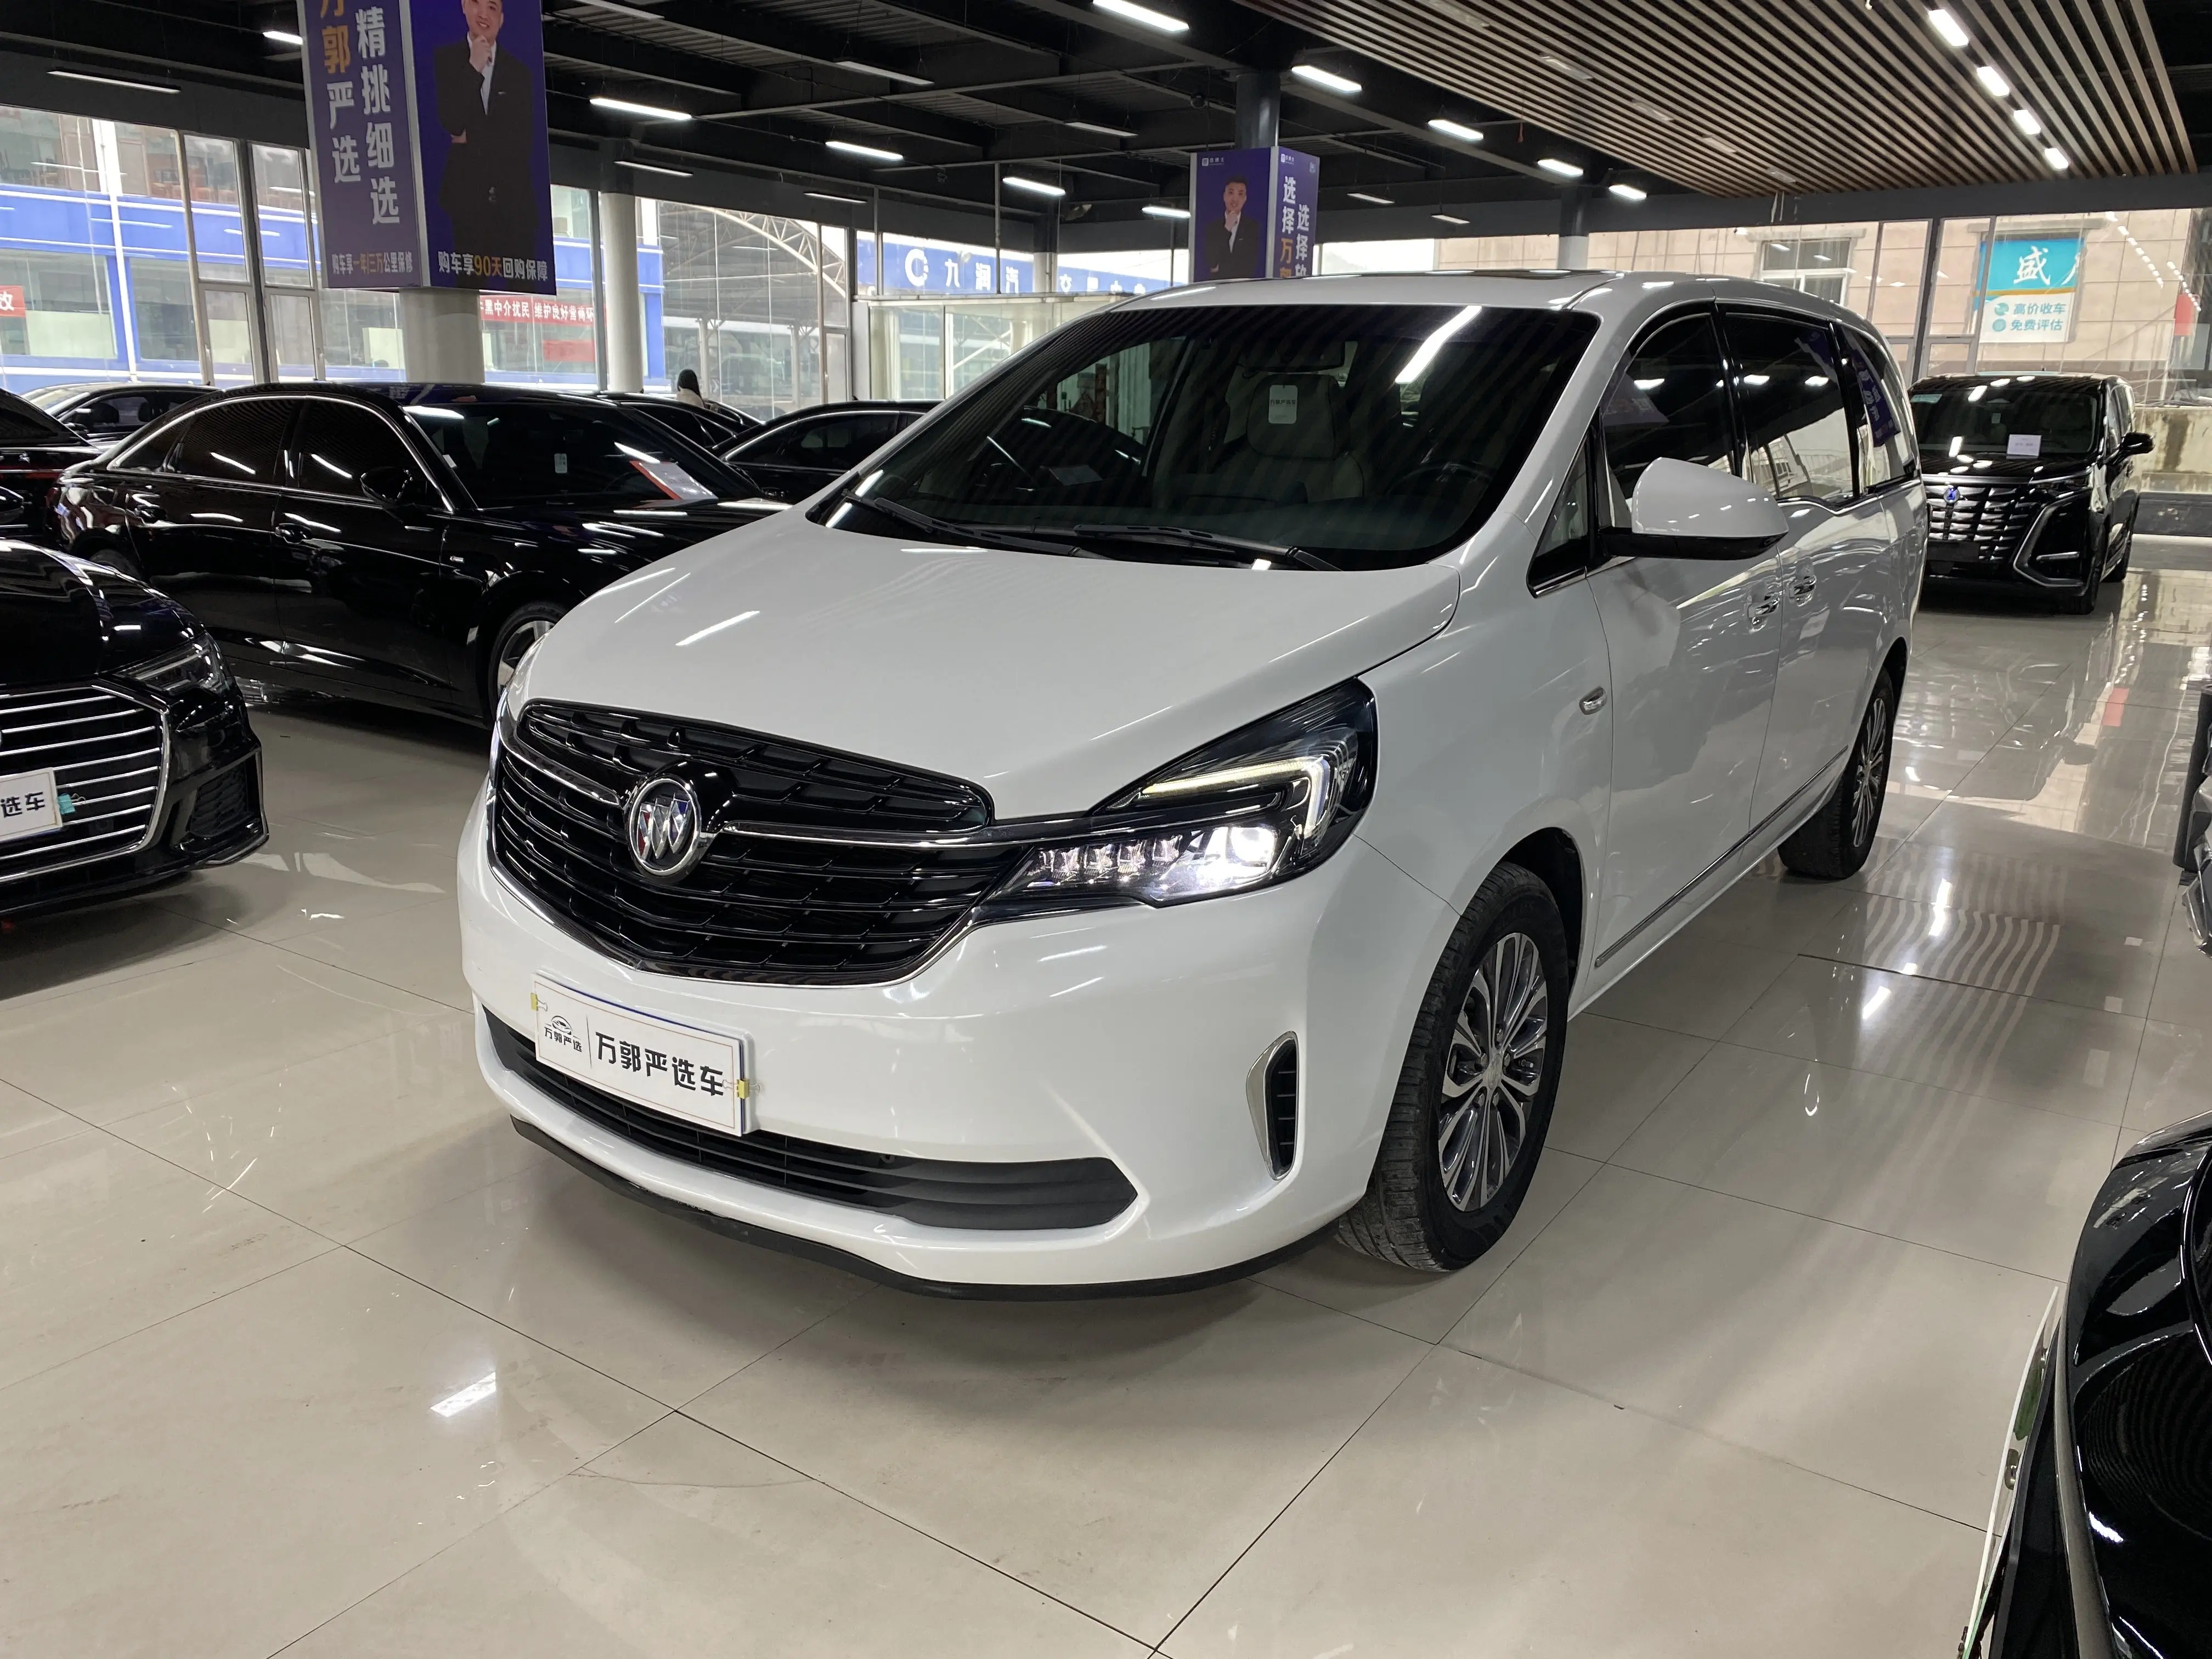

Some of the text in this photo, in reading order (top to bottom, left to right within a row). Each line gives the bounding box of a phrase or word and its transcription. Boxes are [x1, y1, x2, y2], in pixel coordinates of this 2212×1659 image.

[356, 6, 400, 224] 精挑细选
[438, 251, 548, 281] 购车享90天回购保障
[2014, 302, 2066, 314] 高价收车
[2010, 319, 2063, 330] 免费评估
[1, 792, 46, 818] 选车
[544, 1025, 582, 1053] 万郭严选
[595, 1031, 724, 1097] 万郭严选车
